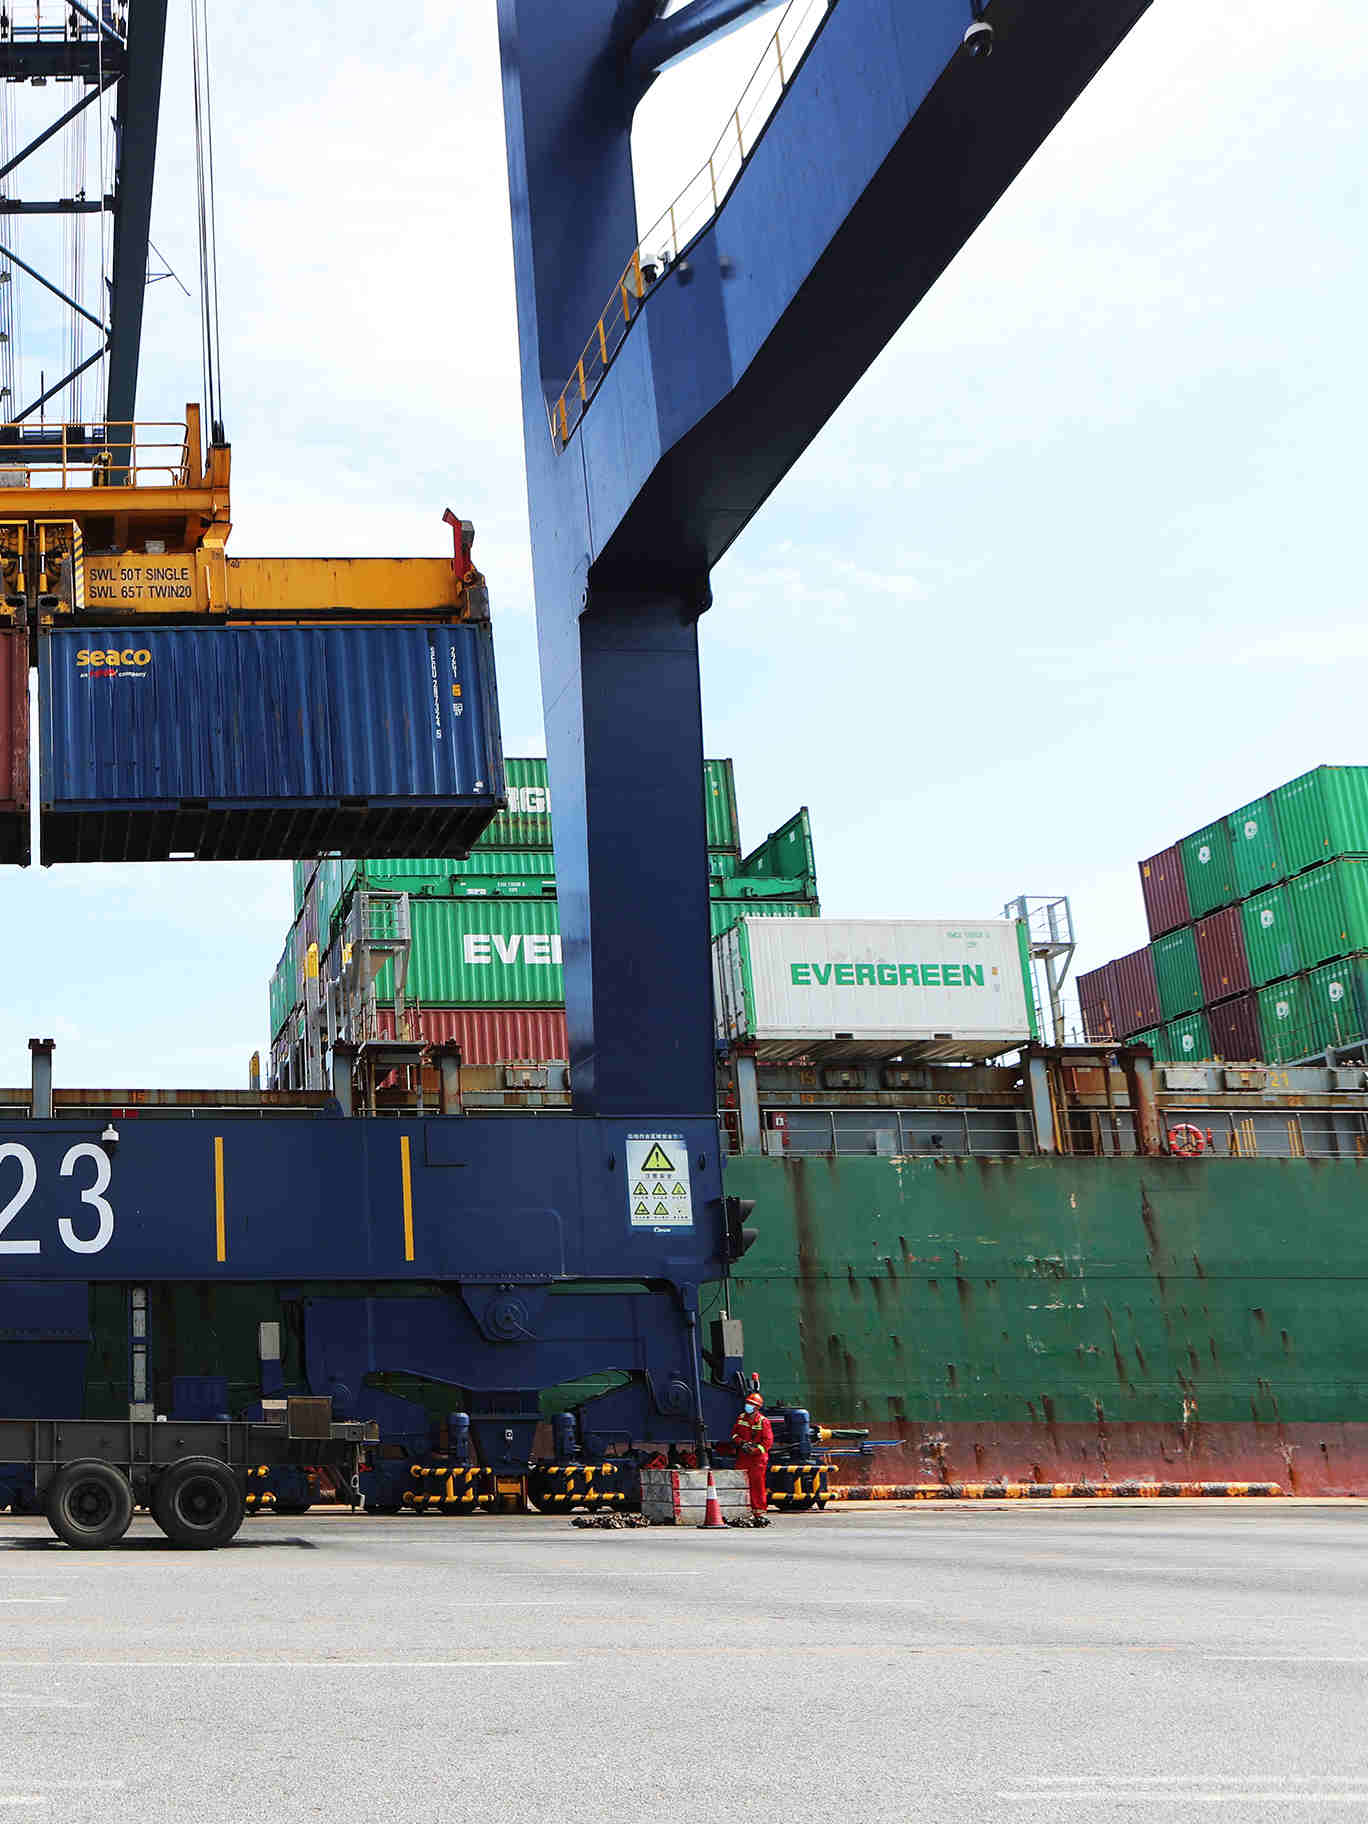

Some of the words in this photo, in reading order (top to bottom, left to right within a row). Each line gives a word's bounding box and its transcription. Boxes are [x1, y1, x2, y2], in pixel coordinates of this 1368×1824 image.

[89, 568, 116, 581] SWL
[120, 568, 142, 581] 50T
[146, 567, 189, 580] SINGLE
[89, 586, 117, 599] SWL
[121, 586, 144, 598] 65T
[148, 585, 192, 598] TWIN20
[76, 649, 151, 666] seaco
[790, 963, 985, 987] EVERGREEN
